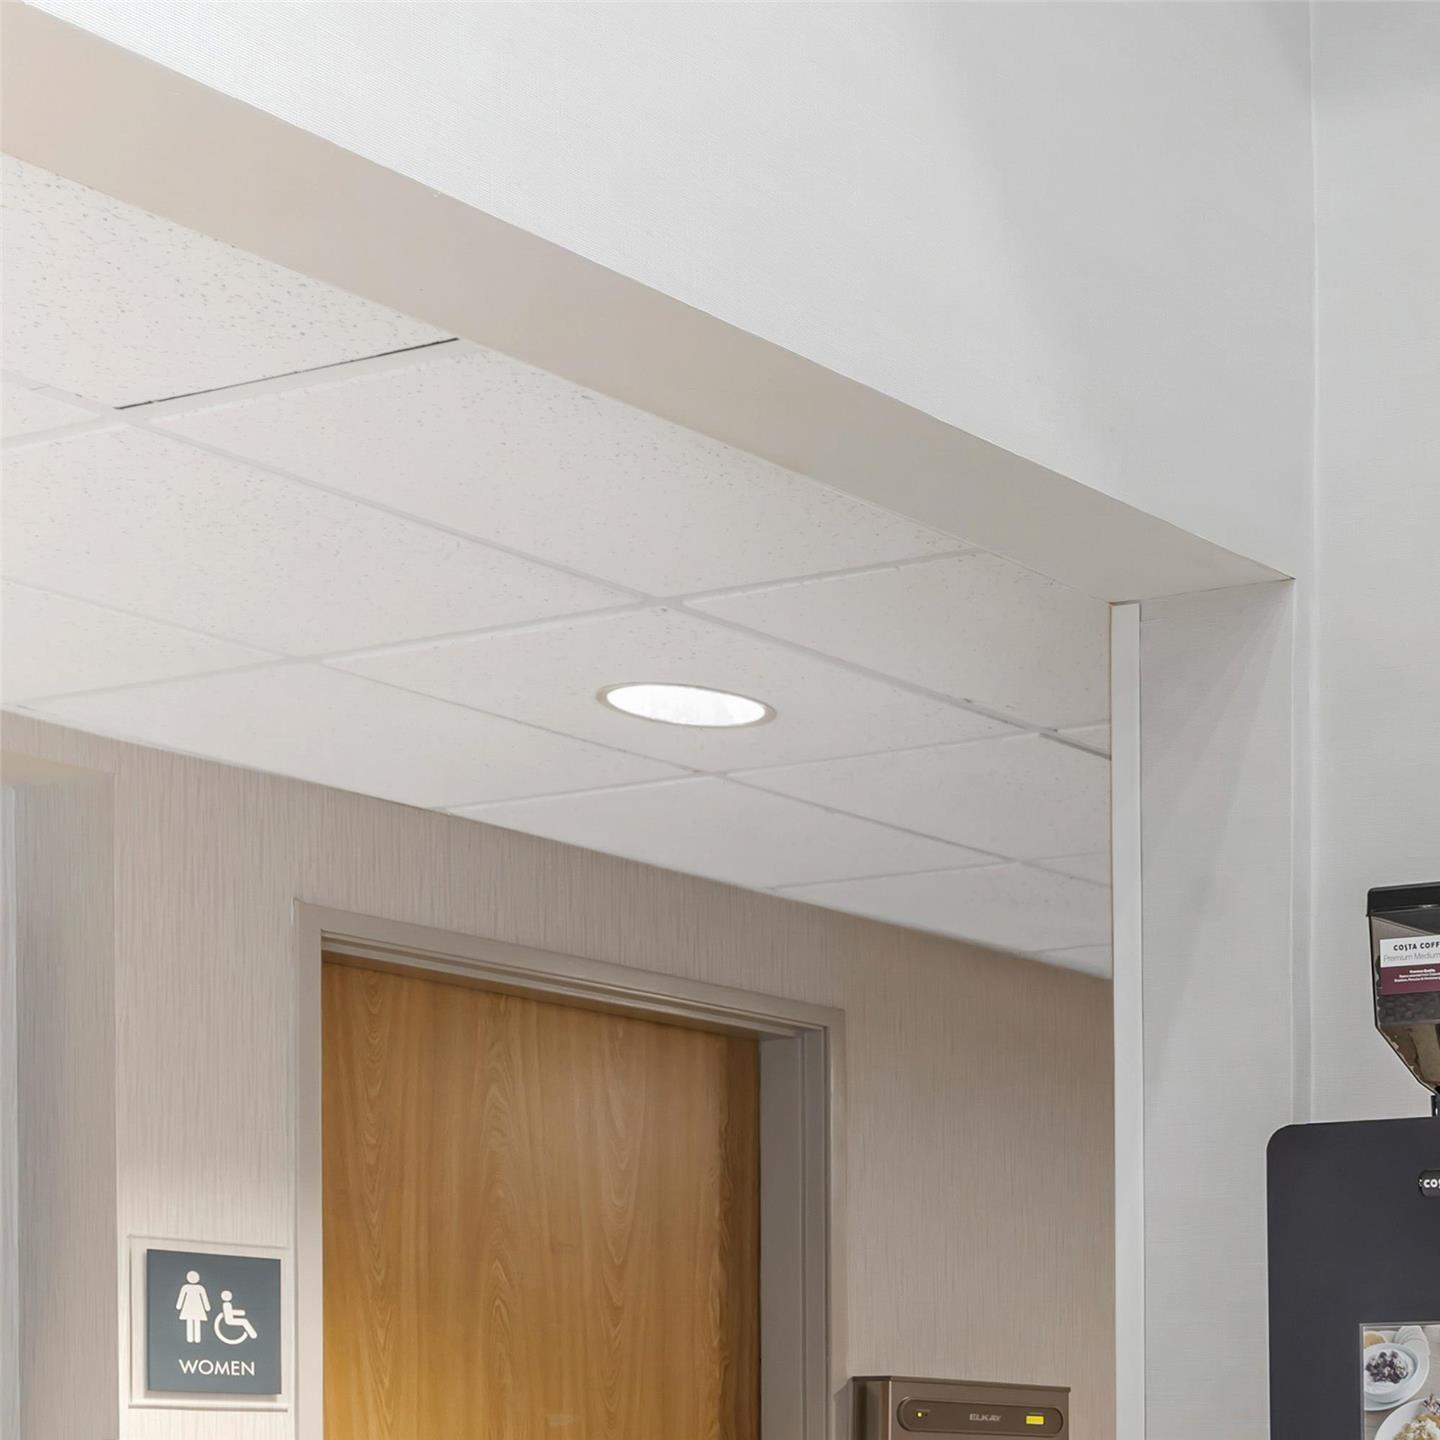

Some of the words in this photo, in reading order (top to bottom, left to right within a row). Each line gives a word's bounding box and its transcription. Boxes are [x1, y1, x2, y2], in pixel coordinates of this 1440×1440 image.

[1393, 943, 1417, 951] COSTA
[1384, 954, 1414, 962] Premium
[1414, 952, 1440, 960] Medium
[178, 1359, 255, 1376] WOMEN
[969, 1413, 1002, 1422] ELKAY
